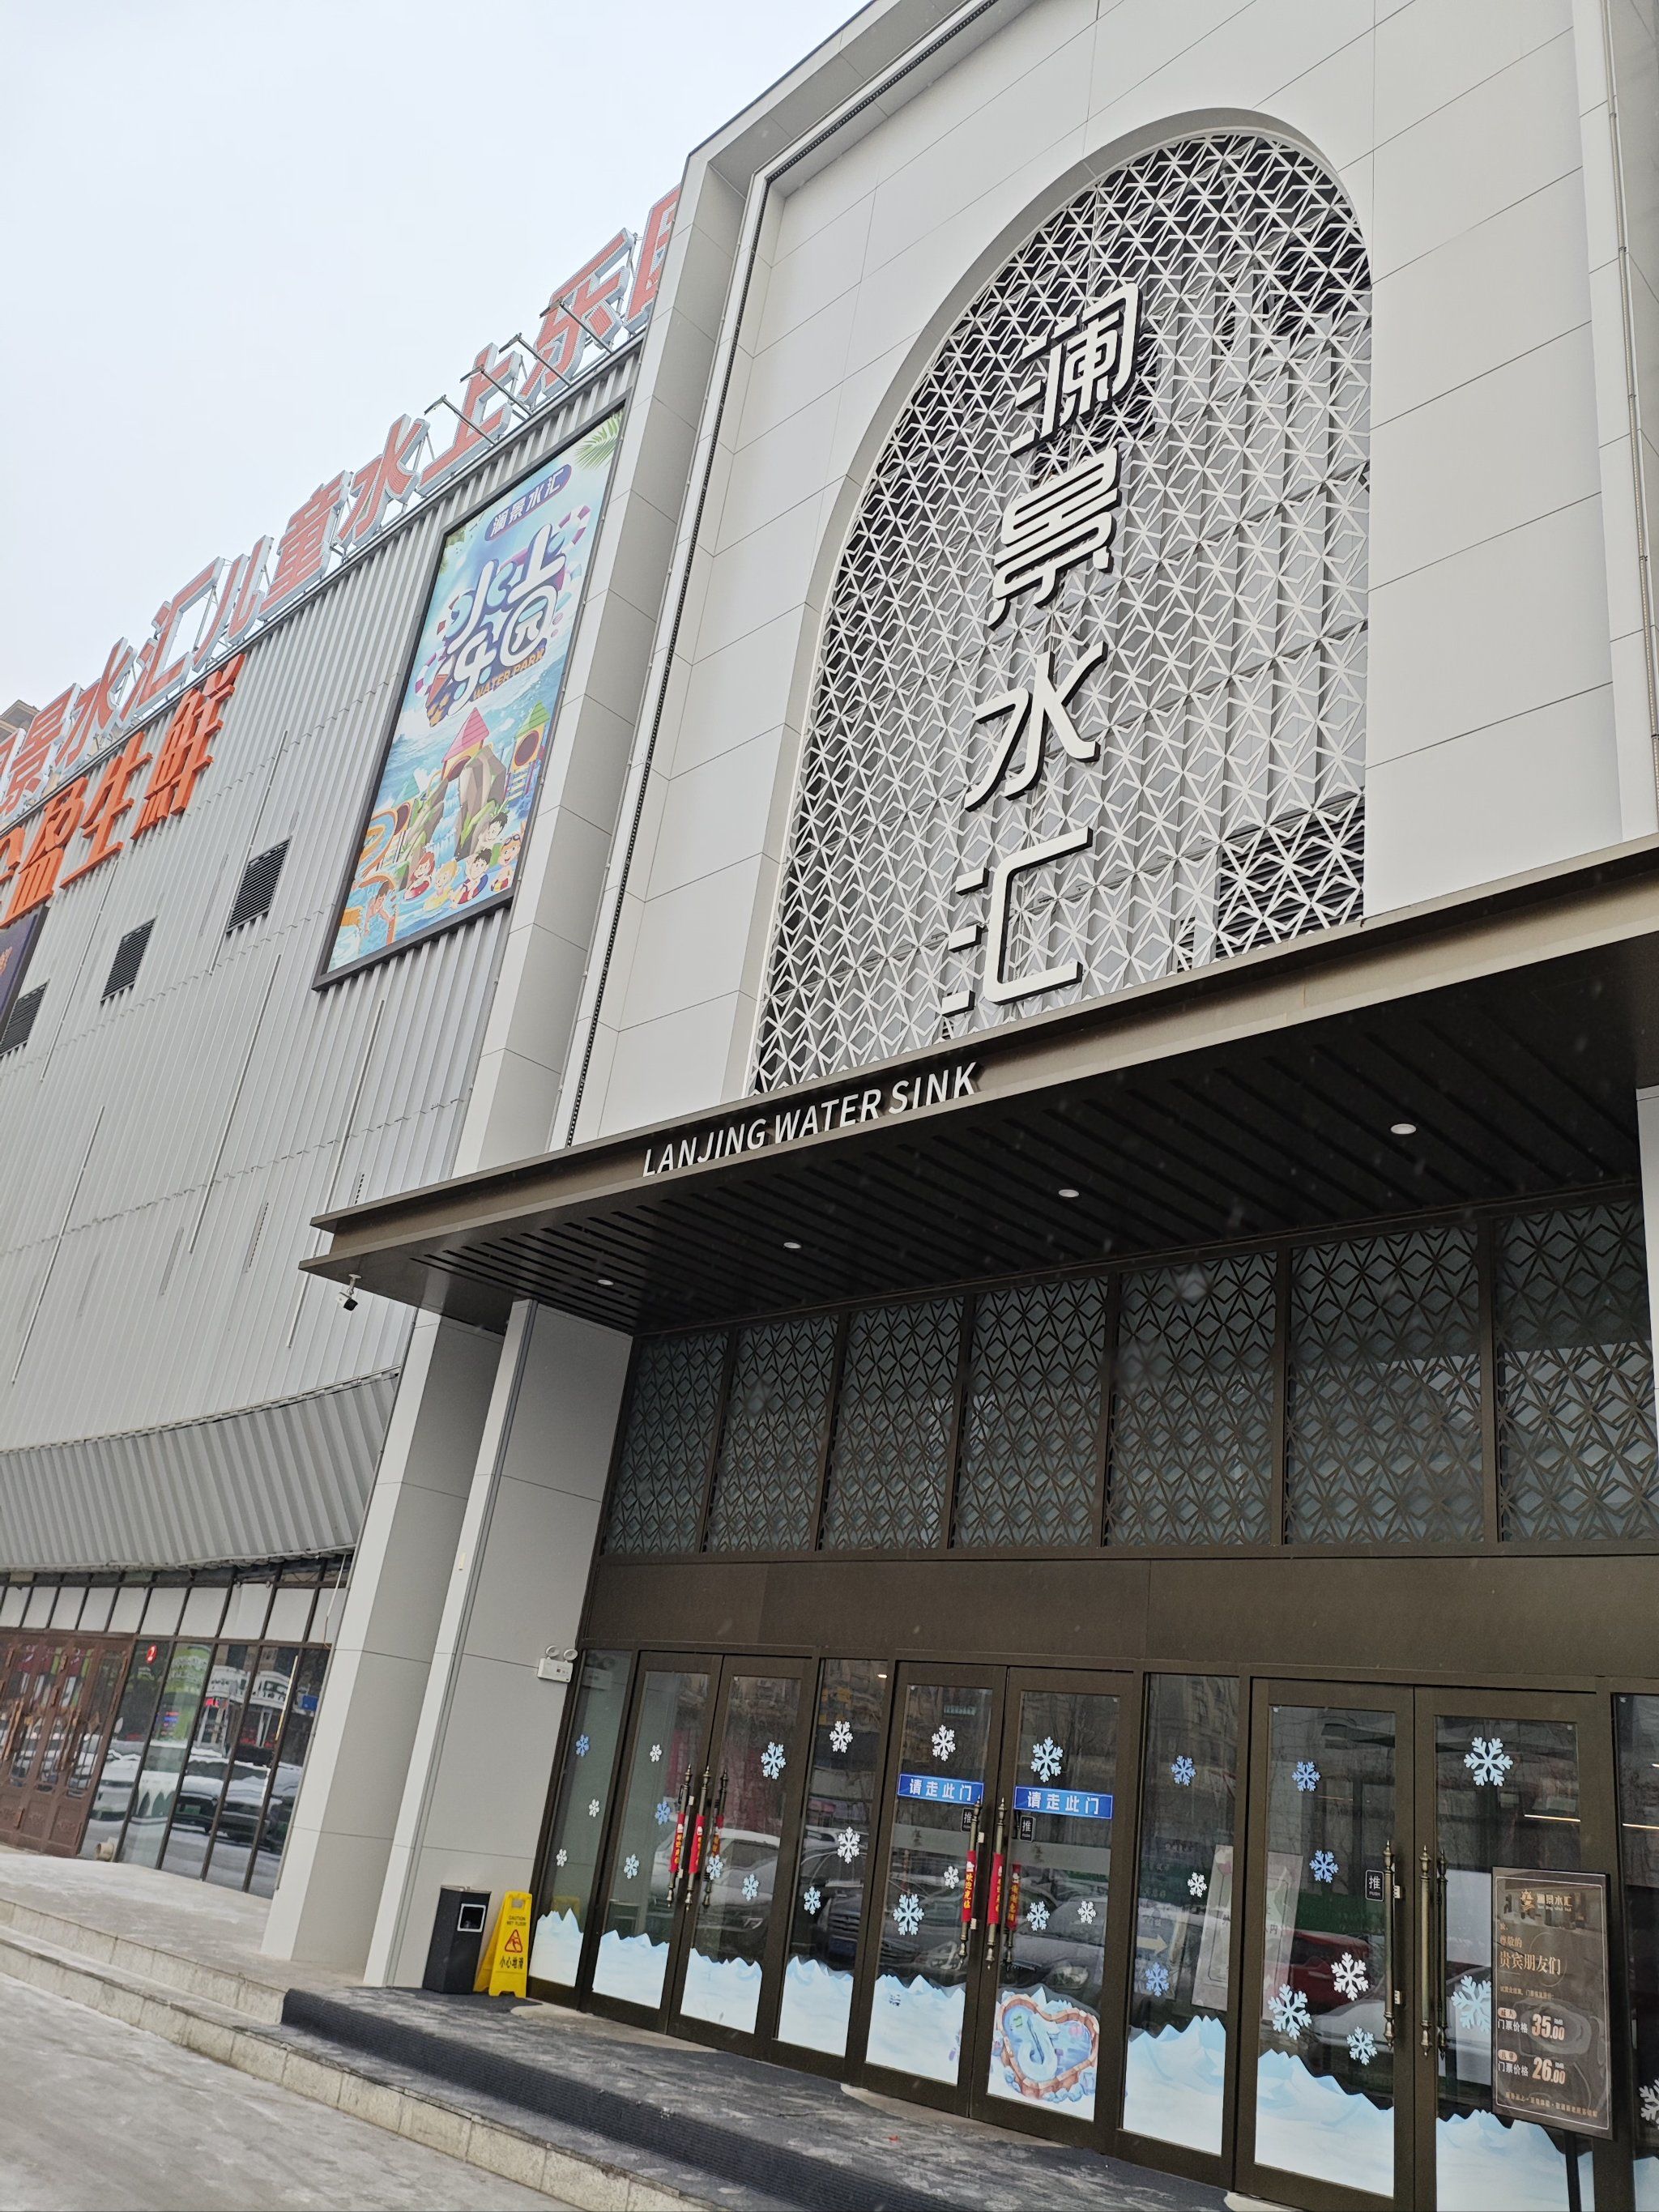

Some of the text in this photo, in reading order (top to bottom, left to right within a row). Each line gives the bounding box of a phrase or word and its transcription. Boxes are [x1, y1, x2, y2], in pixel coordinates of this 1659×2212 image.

[0, 185, 682, 816] 景水汇儿童水上乐
[493, 466, 565, 536] 澜景水汇
[941, 283, 1141, 1012] 澜景水汇
[473, 647, 546, 701] WATER PARK
[0, 653, 246, 927] 盈生鲜
[642, 1062, 977, 1178] LANJING WATER SINK
[909, 1778, 973, 1801] 请走此门
[1027, 1791, 1100, 1815] 请走此门
[1022, 1819, 1031, 1832] 推
[1368, 1875, 1381, 1890] 推
[499, 1956, 524, 1970] 小心地滑
[1499, 1950, 1561, 1975] 贵宾朋友们
[1498, 2019, 1529, 2034] 门票价格
[1531, 2013, 1565, 2041] 35.00
[1498, 2061, 1529, 2078] 门票价格
[1532, 2056, 1566, 2085] 26.00
